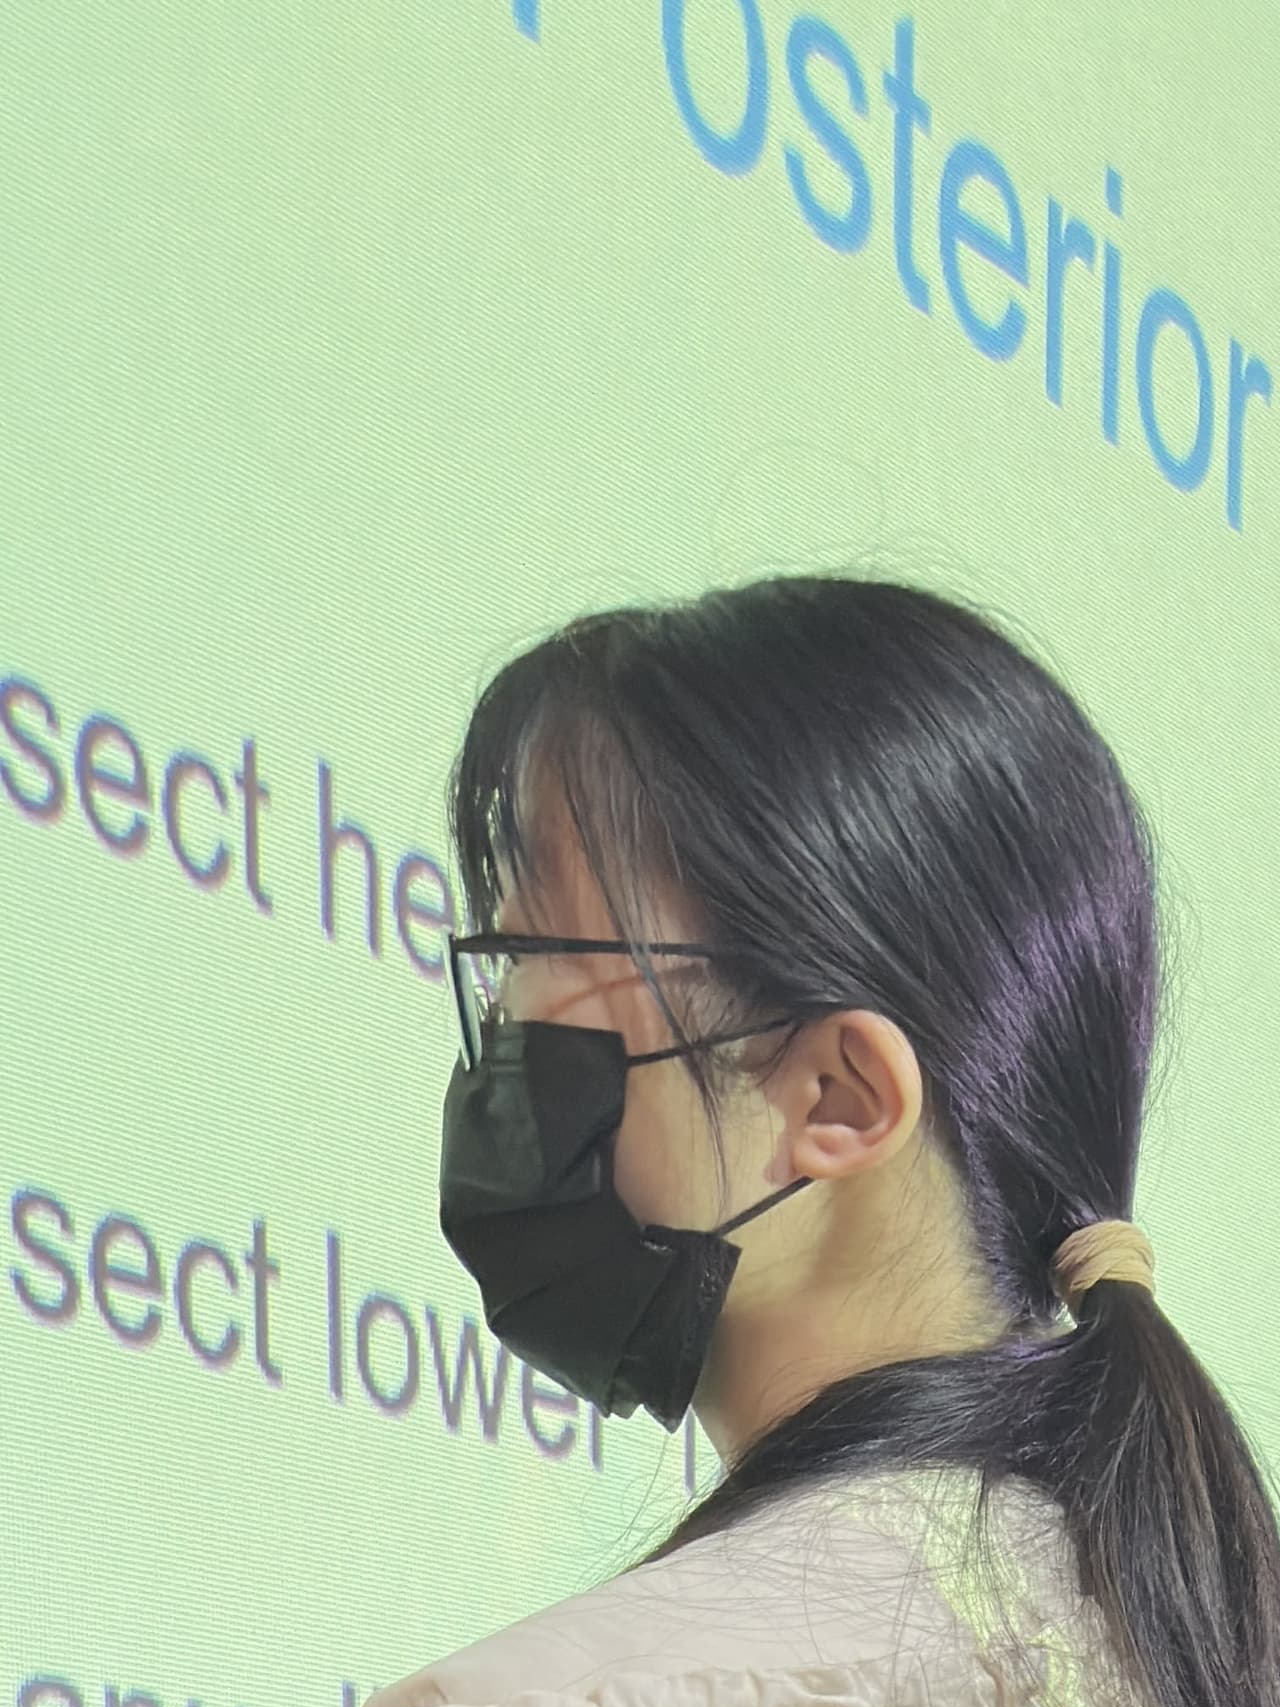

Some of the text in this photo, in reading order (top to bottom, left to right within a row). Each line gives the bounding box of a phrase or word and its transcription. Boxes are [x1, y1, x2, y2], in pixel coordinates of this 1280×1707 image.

[512, 0, 1273, 530] osterior
[0, 672, 456, 984] sect he
[11, 1188, 282, 1390] sect
